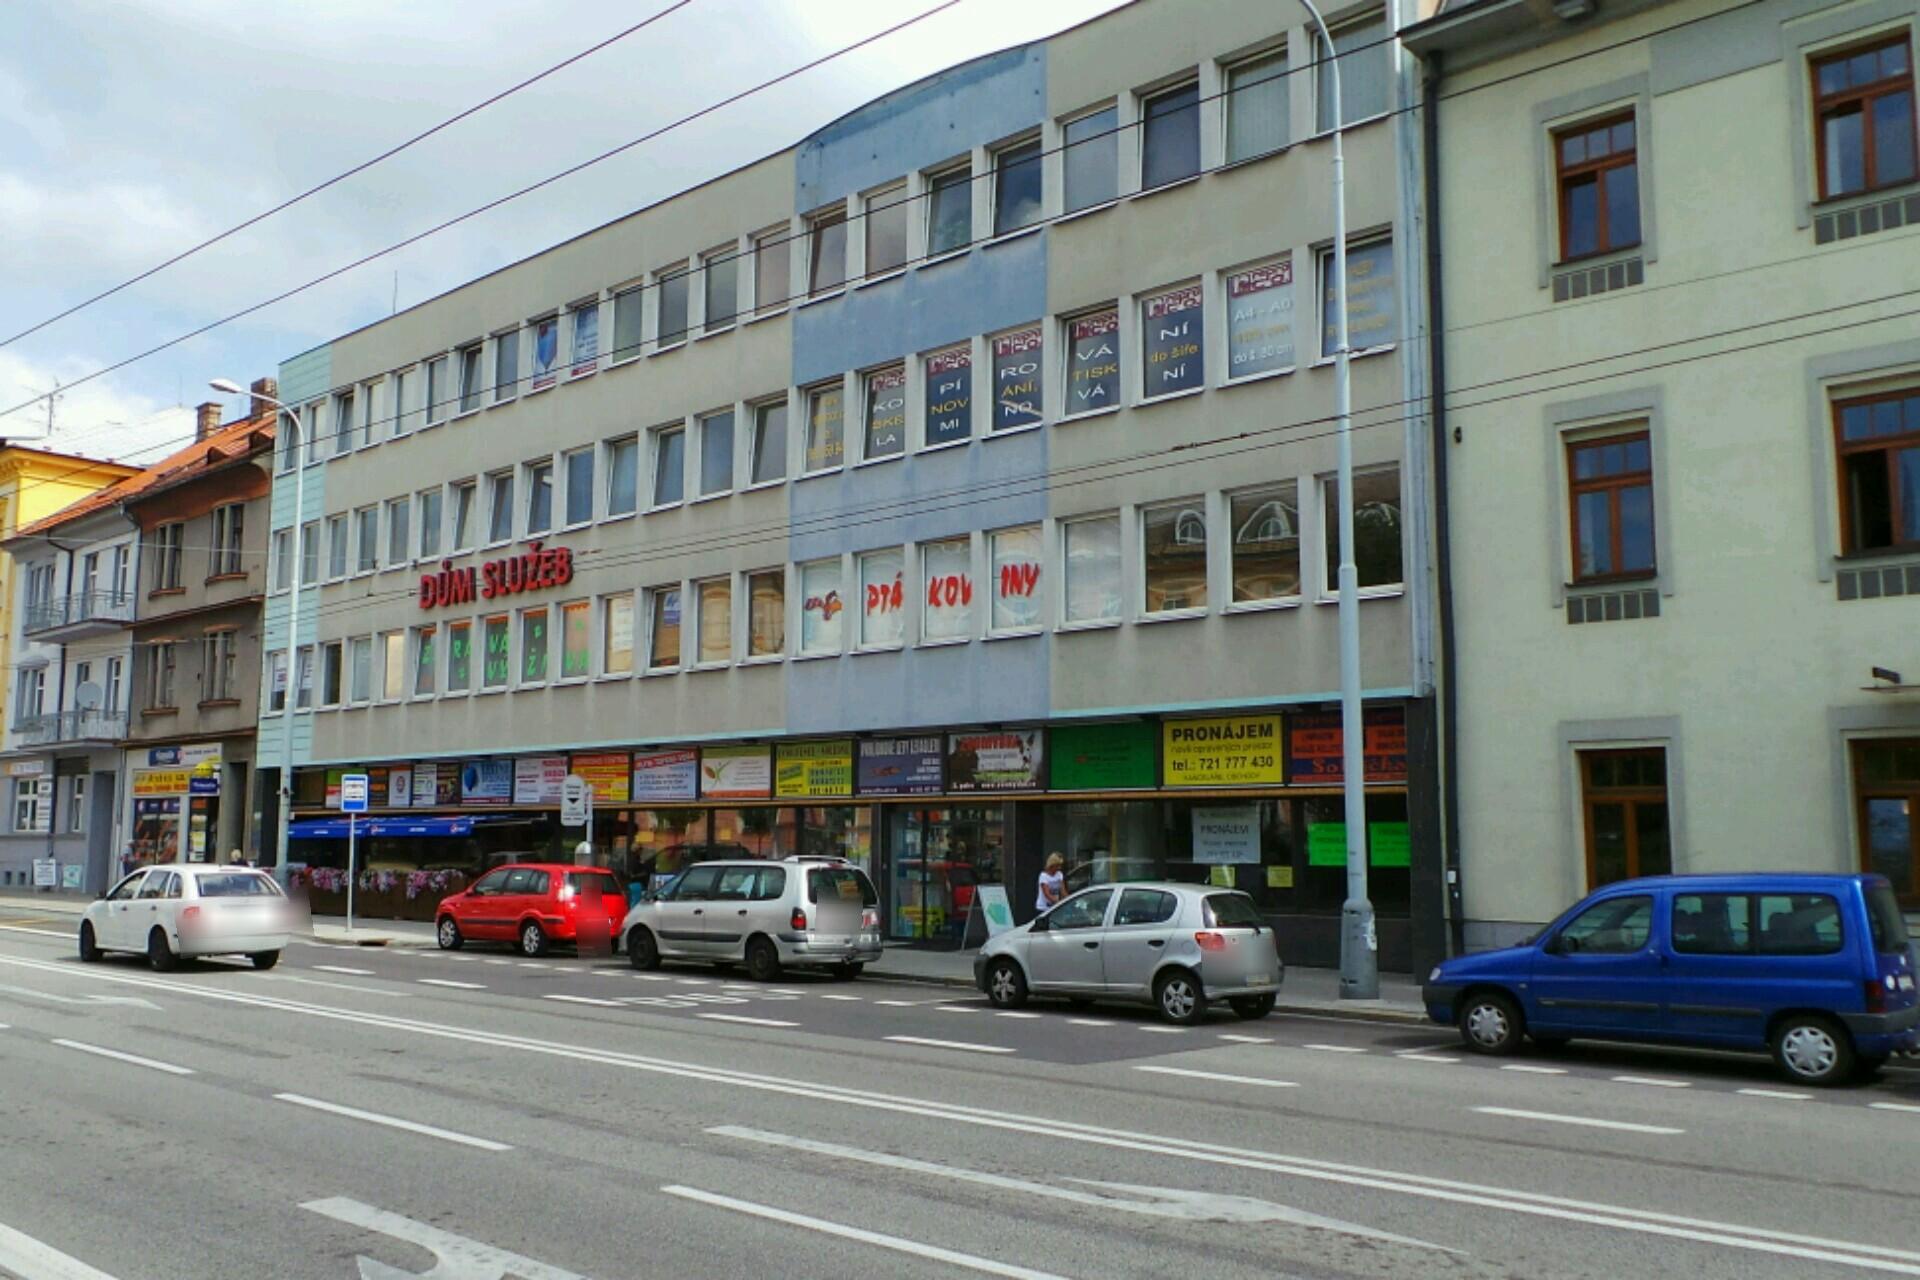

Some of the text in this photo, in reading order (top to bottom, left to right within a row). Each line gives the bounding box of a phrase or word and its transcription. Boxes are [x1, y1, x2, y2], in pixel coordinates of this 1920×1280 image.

[873, 398, 904, 413] KO
[1001, 362, 1037, 380] RO
[930, 397, 968, 415] NOV
[1073, 363, 1117, 382] TISK
[876, 433, 896, 447] LA
[939, 418, 959, 432] MI
[419, 541, 573, 609] DŮM SLUŽEB
[1000, 561, 1041, 599] INY
[1172, 721, 1273, 742] PRONÁJEM
[1172, 755, 1274, 771] tel.: 721 777 430
